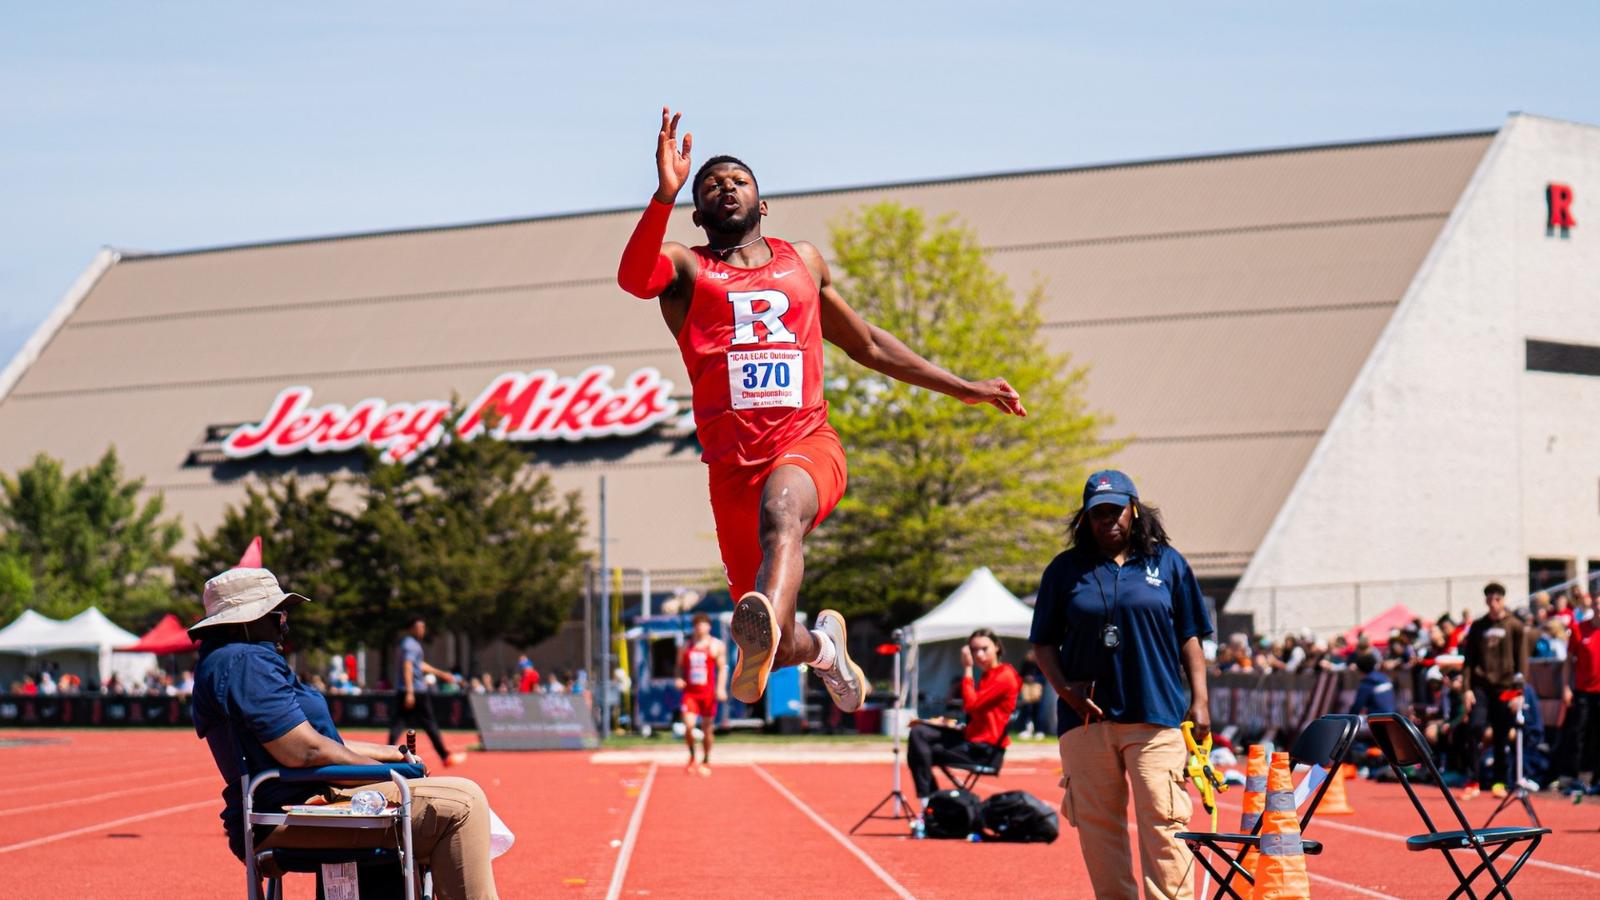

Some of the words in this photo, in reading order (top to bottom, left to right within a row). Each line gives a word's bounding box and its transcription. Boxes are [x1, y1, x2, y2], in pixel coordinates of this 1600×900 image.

[1547, 183, 1576, 227] R
[727, 289, 797, 345] R
[750, 352, 768, 361] ECAC
[770, 351, 797, 360] Outdoor
[742, 362, 790, 389] 370
[741, 389, 793, 399] Championships
[223, 387, 456, 463] Jersey
[457, 365, 677, 441] Mike's
